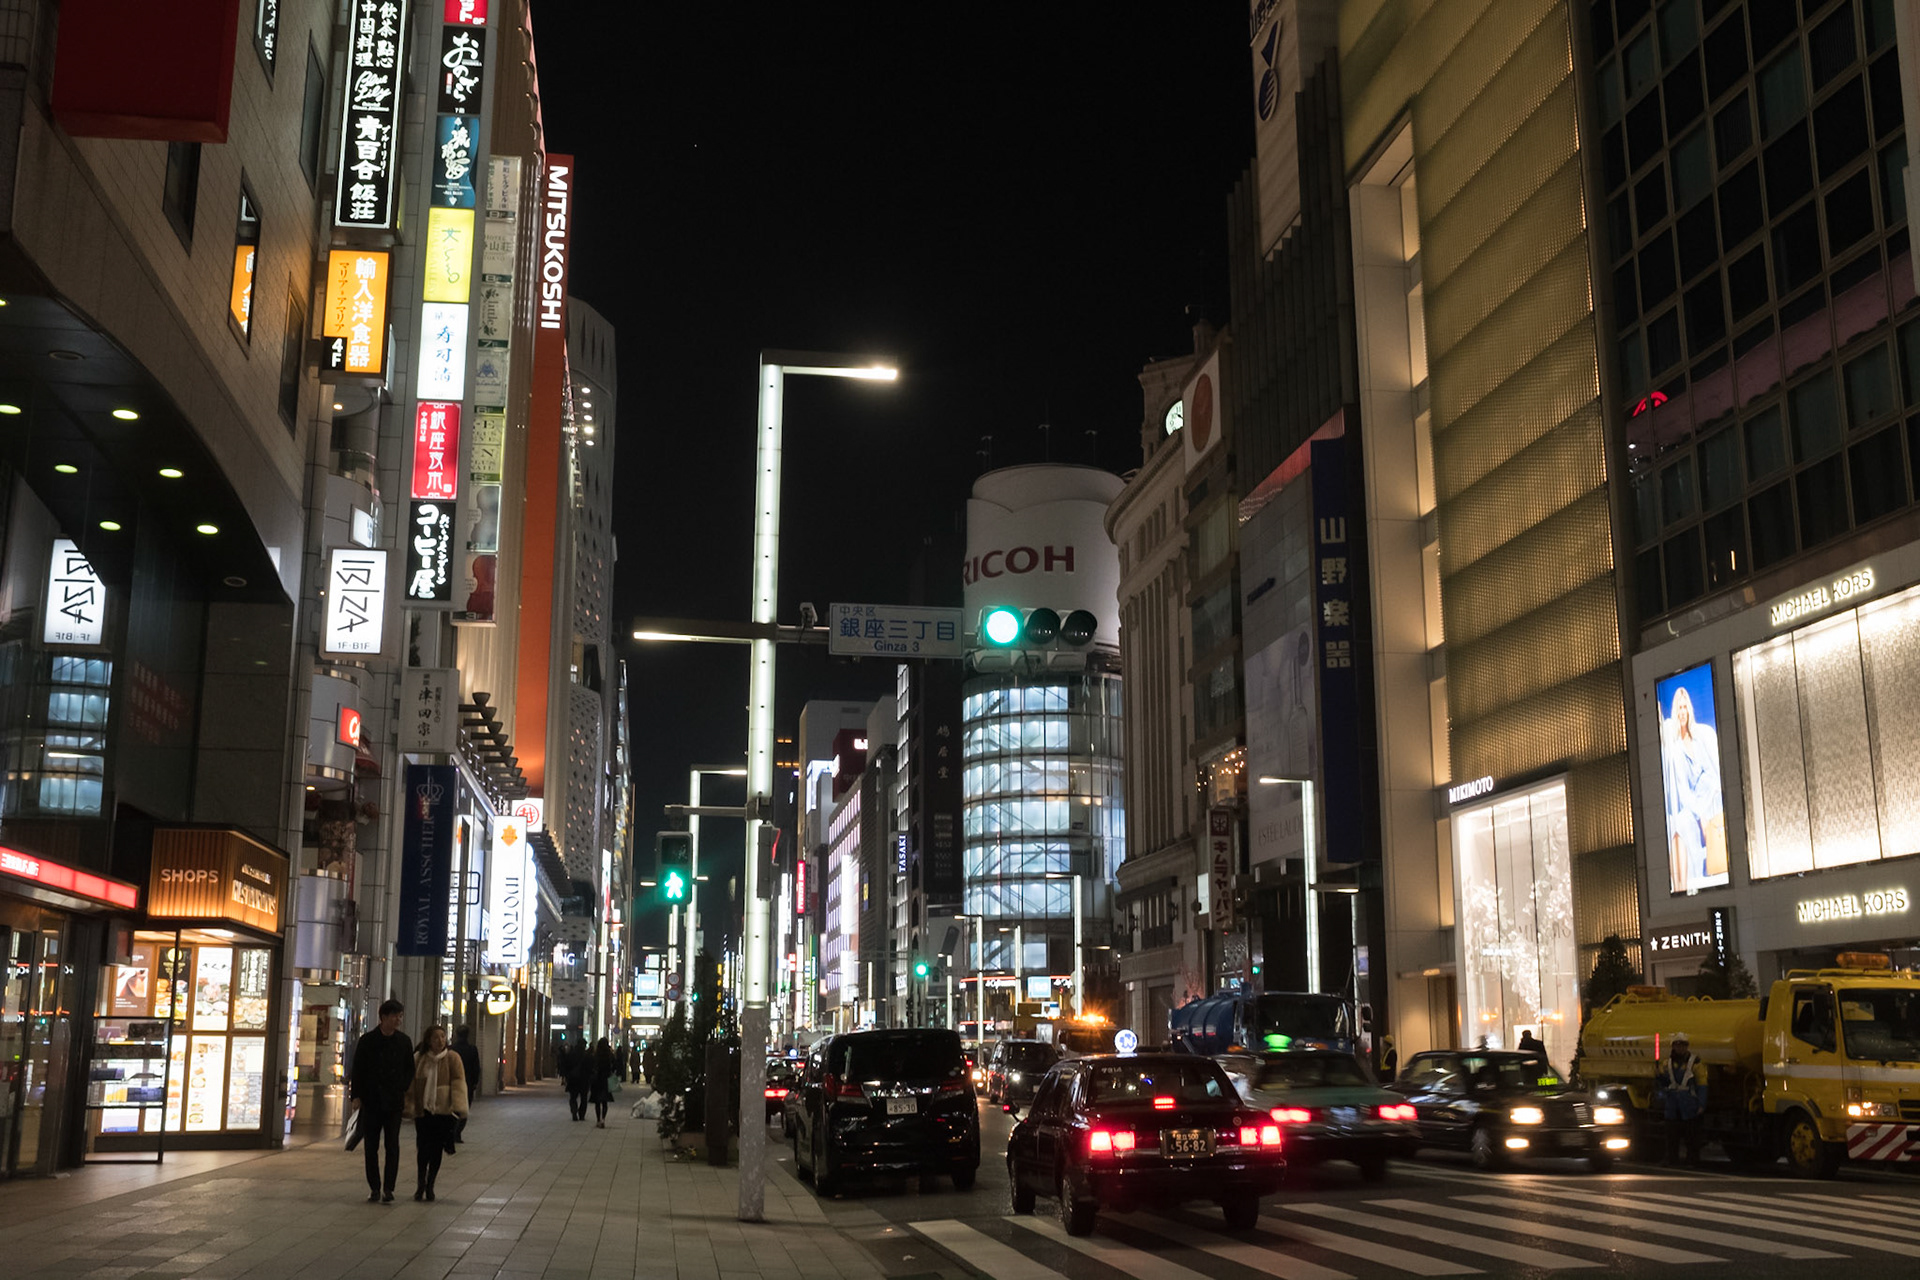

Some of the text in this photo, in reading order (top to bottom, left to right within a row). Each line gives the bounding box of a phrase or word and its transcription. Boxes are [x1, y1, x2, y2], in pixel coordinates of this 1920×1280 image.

[349, 114, 383, 220] 青百合飯荘
[541, 165, 569, 329] MITSUKOSHI
[348, 256, 377, 368] 輸入洋食器
[331, 337, 343, 367] 4F
[409, 503, 440, 599] コーヒー屋
[963, 546, 1075, 587] RICOH
[840, 605, 877, 617] 中央区
[1320, 516, 1351, 669] 山野楽器
[1769, 568, 1875, 626] MICHAEL KORS
[839, 617, 955, 641] 銀座三丁目
[873, 640, 920, 653] Ginza 3
[1448, 775, 1494, 804] MIKIMOTO
[898, 834, 907, 873] TASAKI
[161, 868, 219, 883] SHOPS
[415, 894, 431, 946] ROYAL
[1796, 885, 1909, 923] MICHAEL KORS
[1661, 931, 1711, 950] ZENITH
